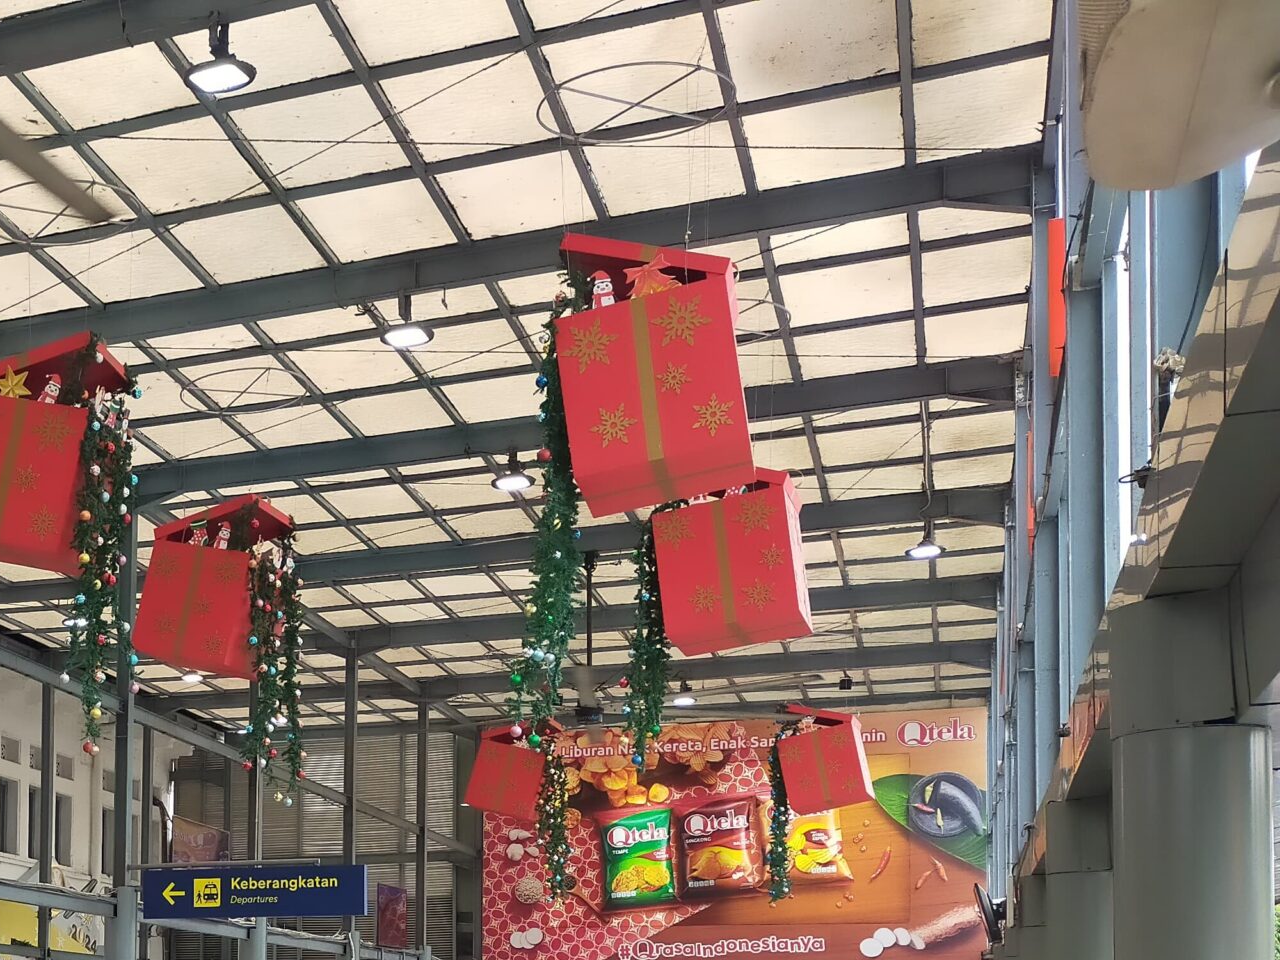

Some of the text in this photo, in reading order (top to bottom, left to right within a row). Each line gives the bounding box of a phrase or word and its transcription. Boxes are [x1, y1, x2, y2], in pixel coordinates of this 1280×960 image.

[897, 717, 976, 747] Qtela
[562, 745, 614, 758] Liburan
[618, 743, 650, 757] Nak
[654, 741, 706, 754] Kereta,
[710, 737, 747, 750] Enak
[685, 809, 750, 837] Qtela
[607, 822, 669, 848] Qtela
[230, 876, 338, 892] Keberangkatan
[230, 895, 278, 904] Departures
